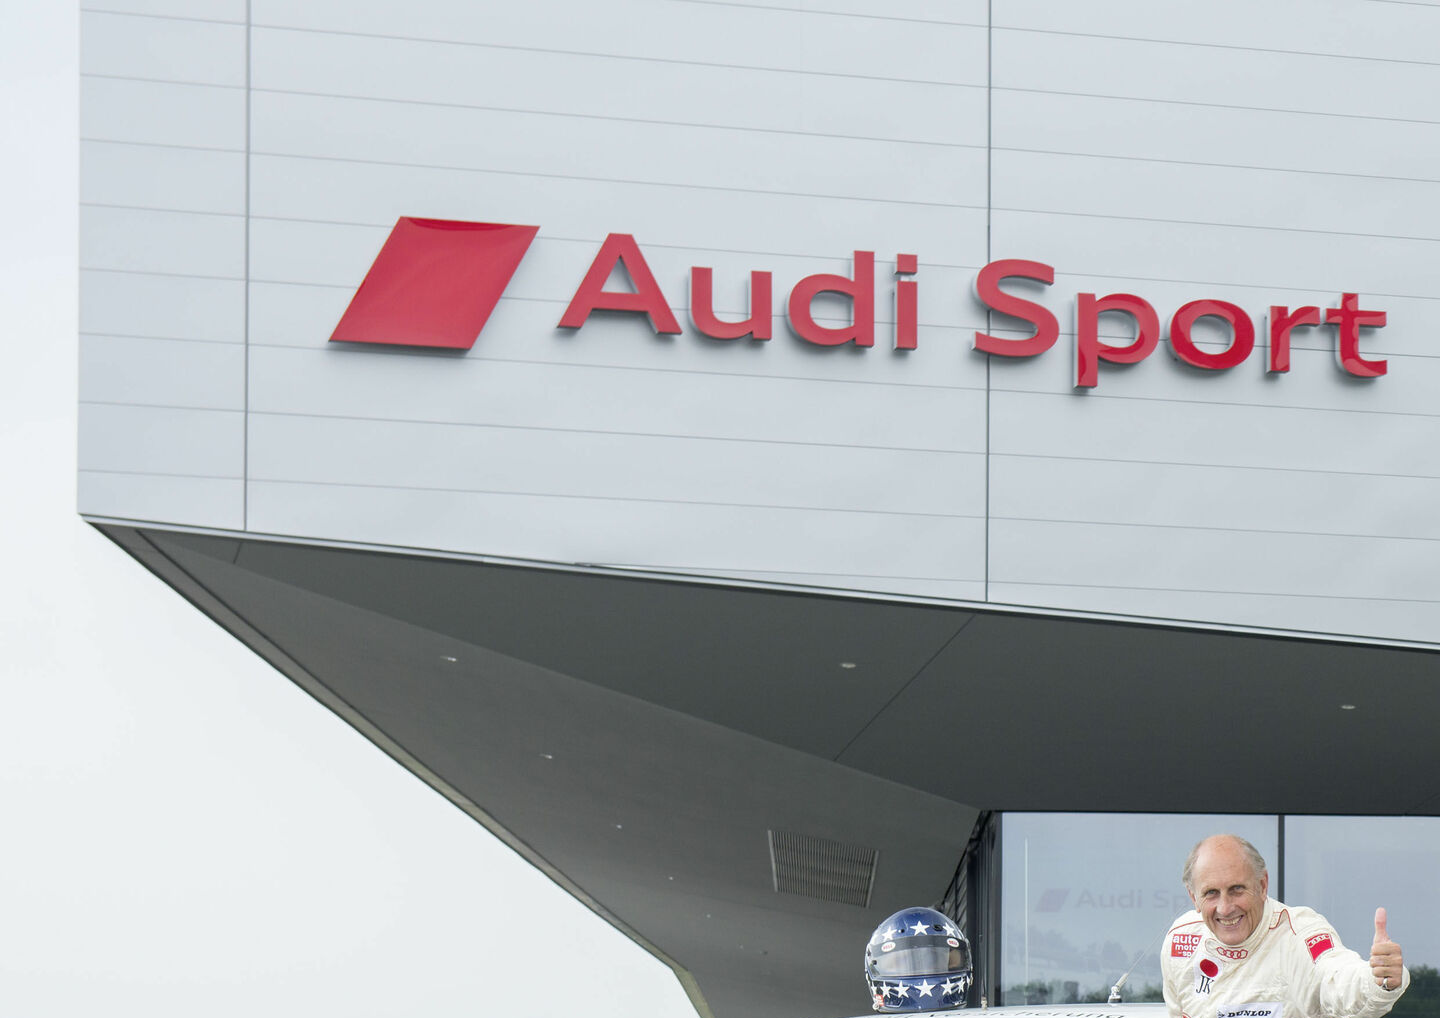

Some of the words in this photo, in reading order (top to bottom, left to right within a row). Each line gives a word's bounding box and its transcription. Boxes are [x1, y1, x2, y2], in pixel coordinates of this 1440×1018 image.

[556, 232, 918, 351] Audi
[970, 258, 1388, 389] Sport
[1196, 974, 1214, 994] JK
[1227, 1009, 1272, 1018] DUNLOP
